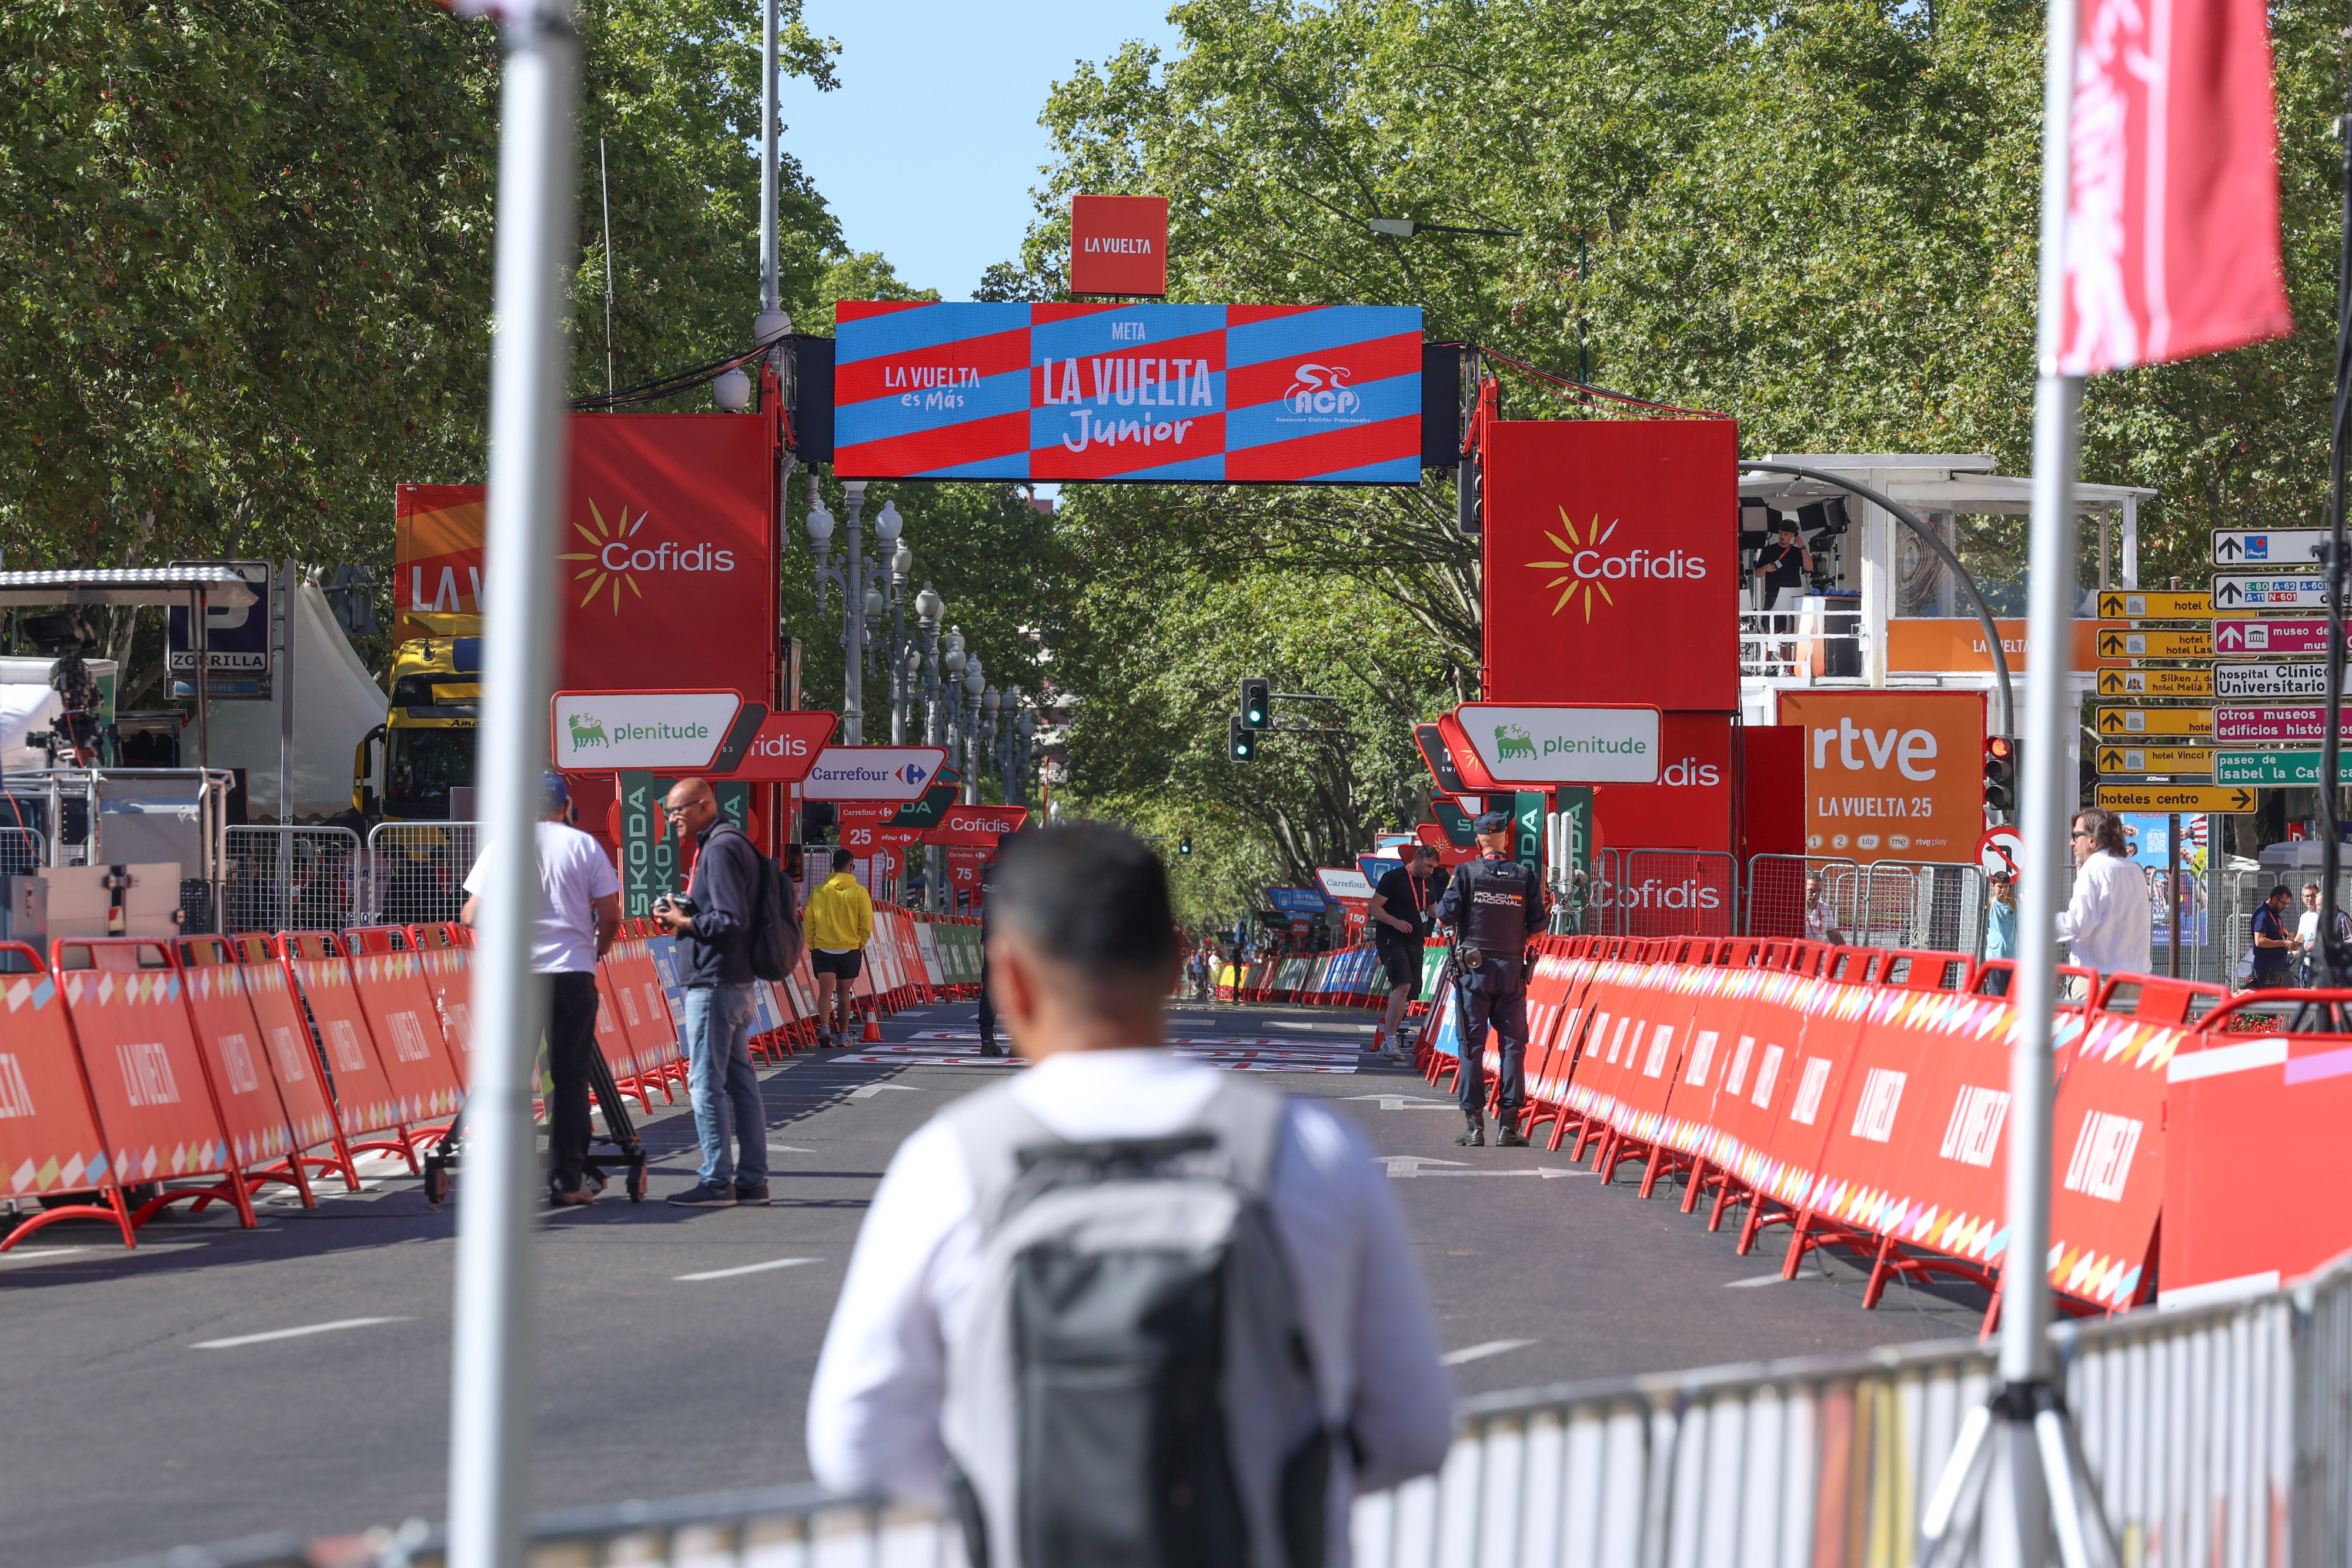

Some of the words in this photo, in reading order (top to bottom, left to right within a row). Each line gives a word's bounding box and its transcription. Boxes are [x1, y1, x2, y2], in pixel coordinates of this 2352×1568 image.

[1085, 238, 1101, 253] LA
[1102, 238, 1151, 254] VUELTA
[1112, 322, 1146, 340] META
[886, 366, 907, 387] LA
[910, 367, 981, 388] VUELTA
[1043, 357, 1083, 404] LA
[1092, 358, 1212, 406] VUELTA
[901, 393, 921, 406] es
[925, 389, 965, 412] Más
[1295, 390, 1355, 414] ACP
[1063, 409, 1193, 453] Junior
[602, 541, 736, 572] Cofidis
[1572, 549, 1706, 579] Cofidis
[412, 566, 461, 613] LA
[2245, 582, 2269, 591] E-80
[2273, 582, 2296, 590] A-62
[2301, 581, 2328, 590] A-601
[2246, 593, 2264, 601] A-11
[2269, 593, 2297, 601] N-601
[2174, 601, 2202, 610] hotel
[2273, 627, 2309, 636] museo
[1973, 639, 1987, 653] LA
[2179, 636, 2203, 644] hotel
[2166, 646, 2190, 654] hotel
[2219, 669, 2269, 681] hospital
[2177, 682, 2203, 691] Meliá
[2219, 679, 2326, 694] Universitario
[2219, 709, 2255, 720] otros
[2263, 710, 2317, 720] museos
[614, 721, 709, 744] plenitude
[2189, 723, 2212, 731] hotel
[1544, 735, 1646, 756] plenitude
[1813, 717, 1937, 781] rtve
[2177, 751, 2204, 759] Vincci
[2220, 757, 2254, 767] paseo
[2261, 755, 2277, 764] de
[811, 767, 889, 781] Carrefour
[2220, 767, 2264, 780] Isabel
[2273, 767, 2286, 778] la
[2101, 793, 2150, 804] hoteles
[2156, 793, 2199, 804] centro
[1819, 797, 1839, 817] LA
[1842, 797, 1907, 817] VUELTA
[1911, 797, 1932, 817] 25
[951, 817, 1010, 833] Cofidis
[850, 828, 872, 845] 25
[1812, 837, 1817, 847] 1
[1837, 837, 1843, 846] 2
[1862, 837, 1875, 846] tdp
[1892, 837, 1906, 846] rne
[1916, 837, 1931, 846] rtve
[1932, 838, 1947, 847] play
[956, 867, 973, 880] 75
[1327, 879, 1367, 888] Carrefour
[1474, 891, 1513, 900] POLICIA
[1590, 879, 1720, 908] Cofidis
[1474, 897, 1522, 907] NACIONAL
[1349, 913, 1365, 924] 150
